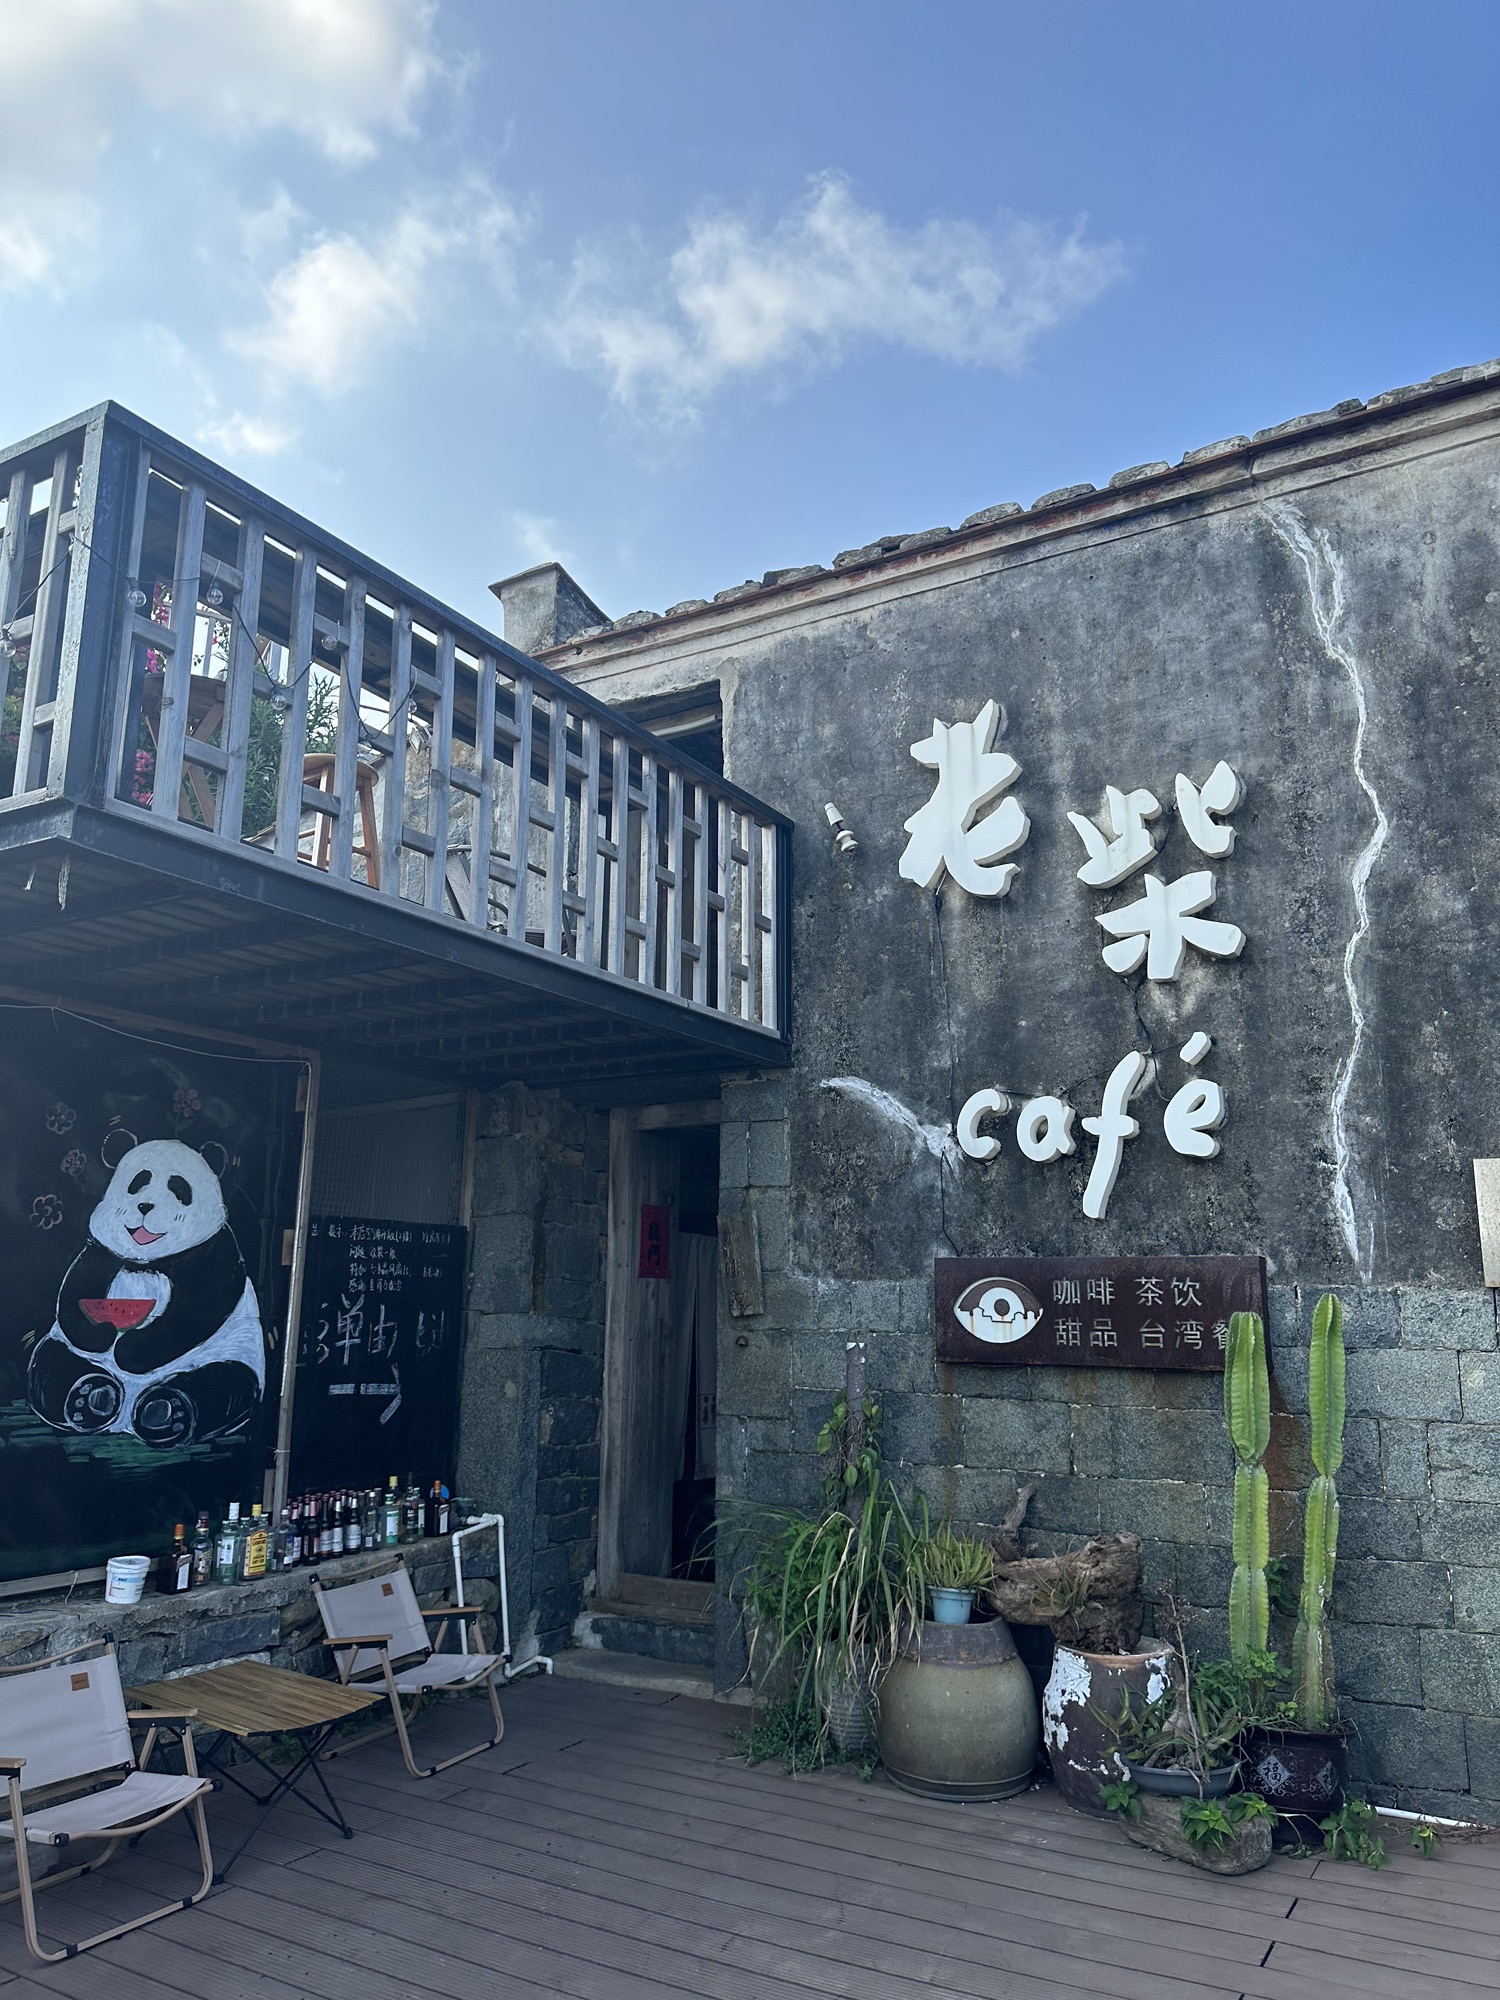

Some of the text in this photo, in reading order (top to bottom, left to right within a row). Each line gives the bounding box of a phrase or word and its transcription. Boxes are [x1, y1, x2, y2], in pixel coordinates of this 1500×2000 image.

[957, 1032, 1227, 1219] café
[1052, 1276, 1203, 1307] 咖啡 茶饮
[1054, 1317, 1118, 1348] 甜品
[1262, 1761, 1282, 1783] 福
